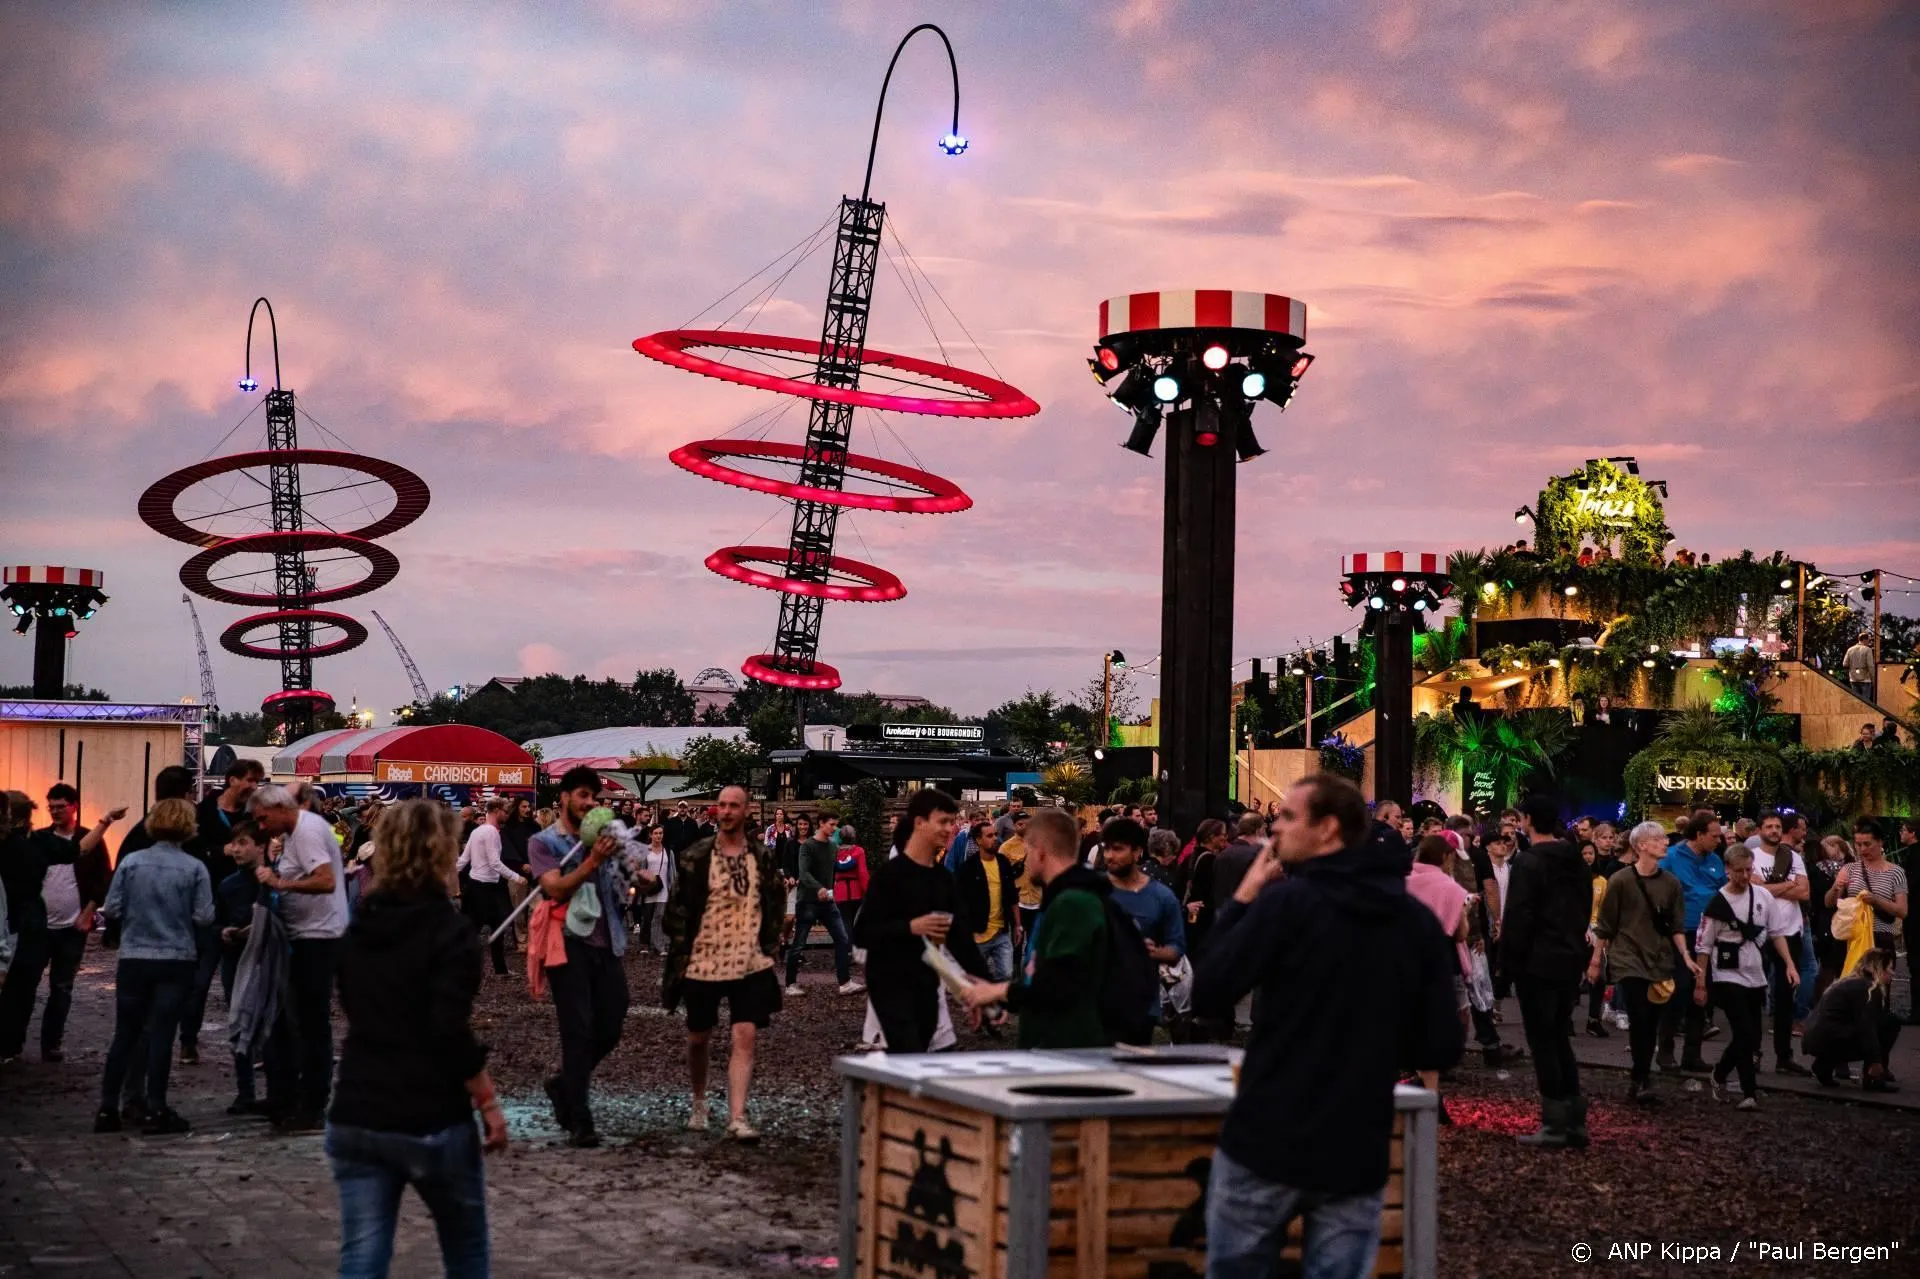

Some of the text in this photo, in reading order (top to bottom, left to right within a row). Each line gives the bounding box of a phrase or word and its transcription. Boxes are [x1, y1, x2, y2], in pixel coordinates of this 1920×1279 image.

[886, 726, 921, 738] kroketterij
[927, 727, 936, 737] DE
[423, 766, 488, 783] CARIBISCH
[1473, 780, 1495, 789] secret
[1657, 774, 1747, 792] NESPRESSO
[1469, 788, 1494, 800] getaway
